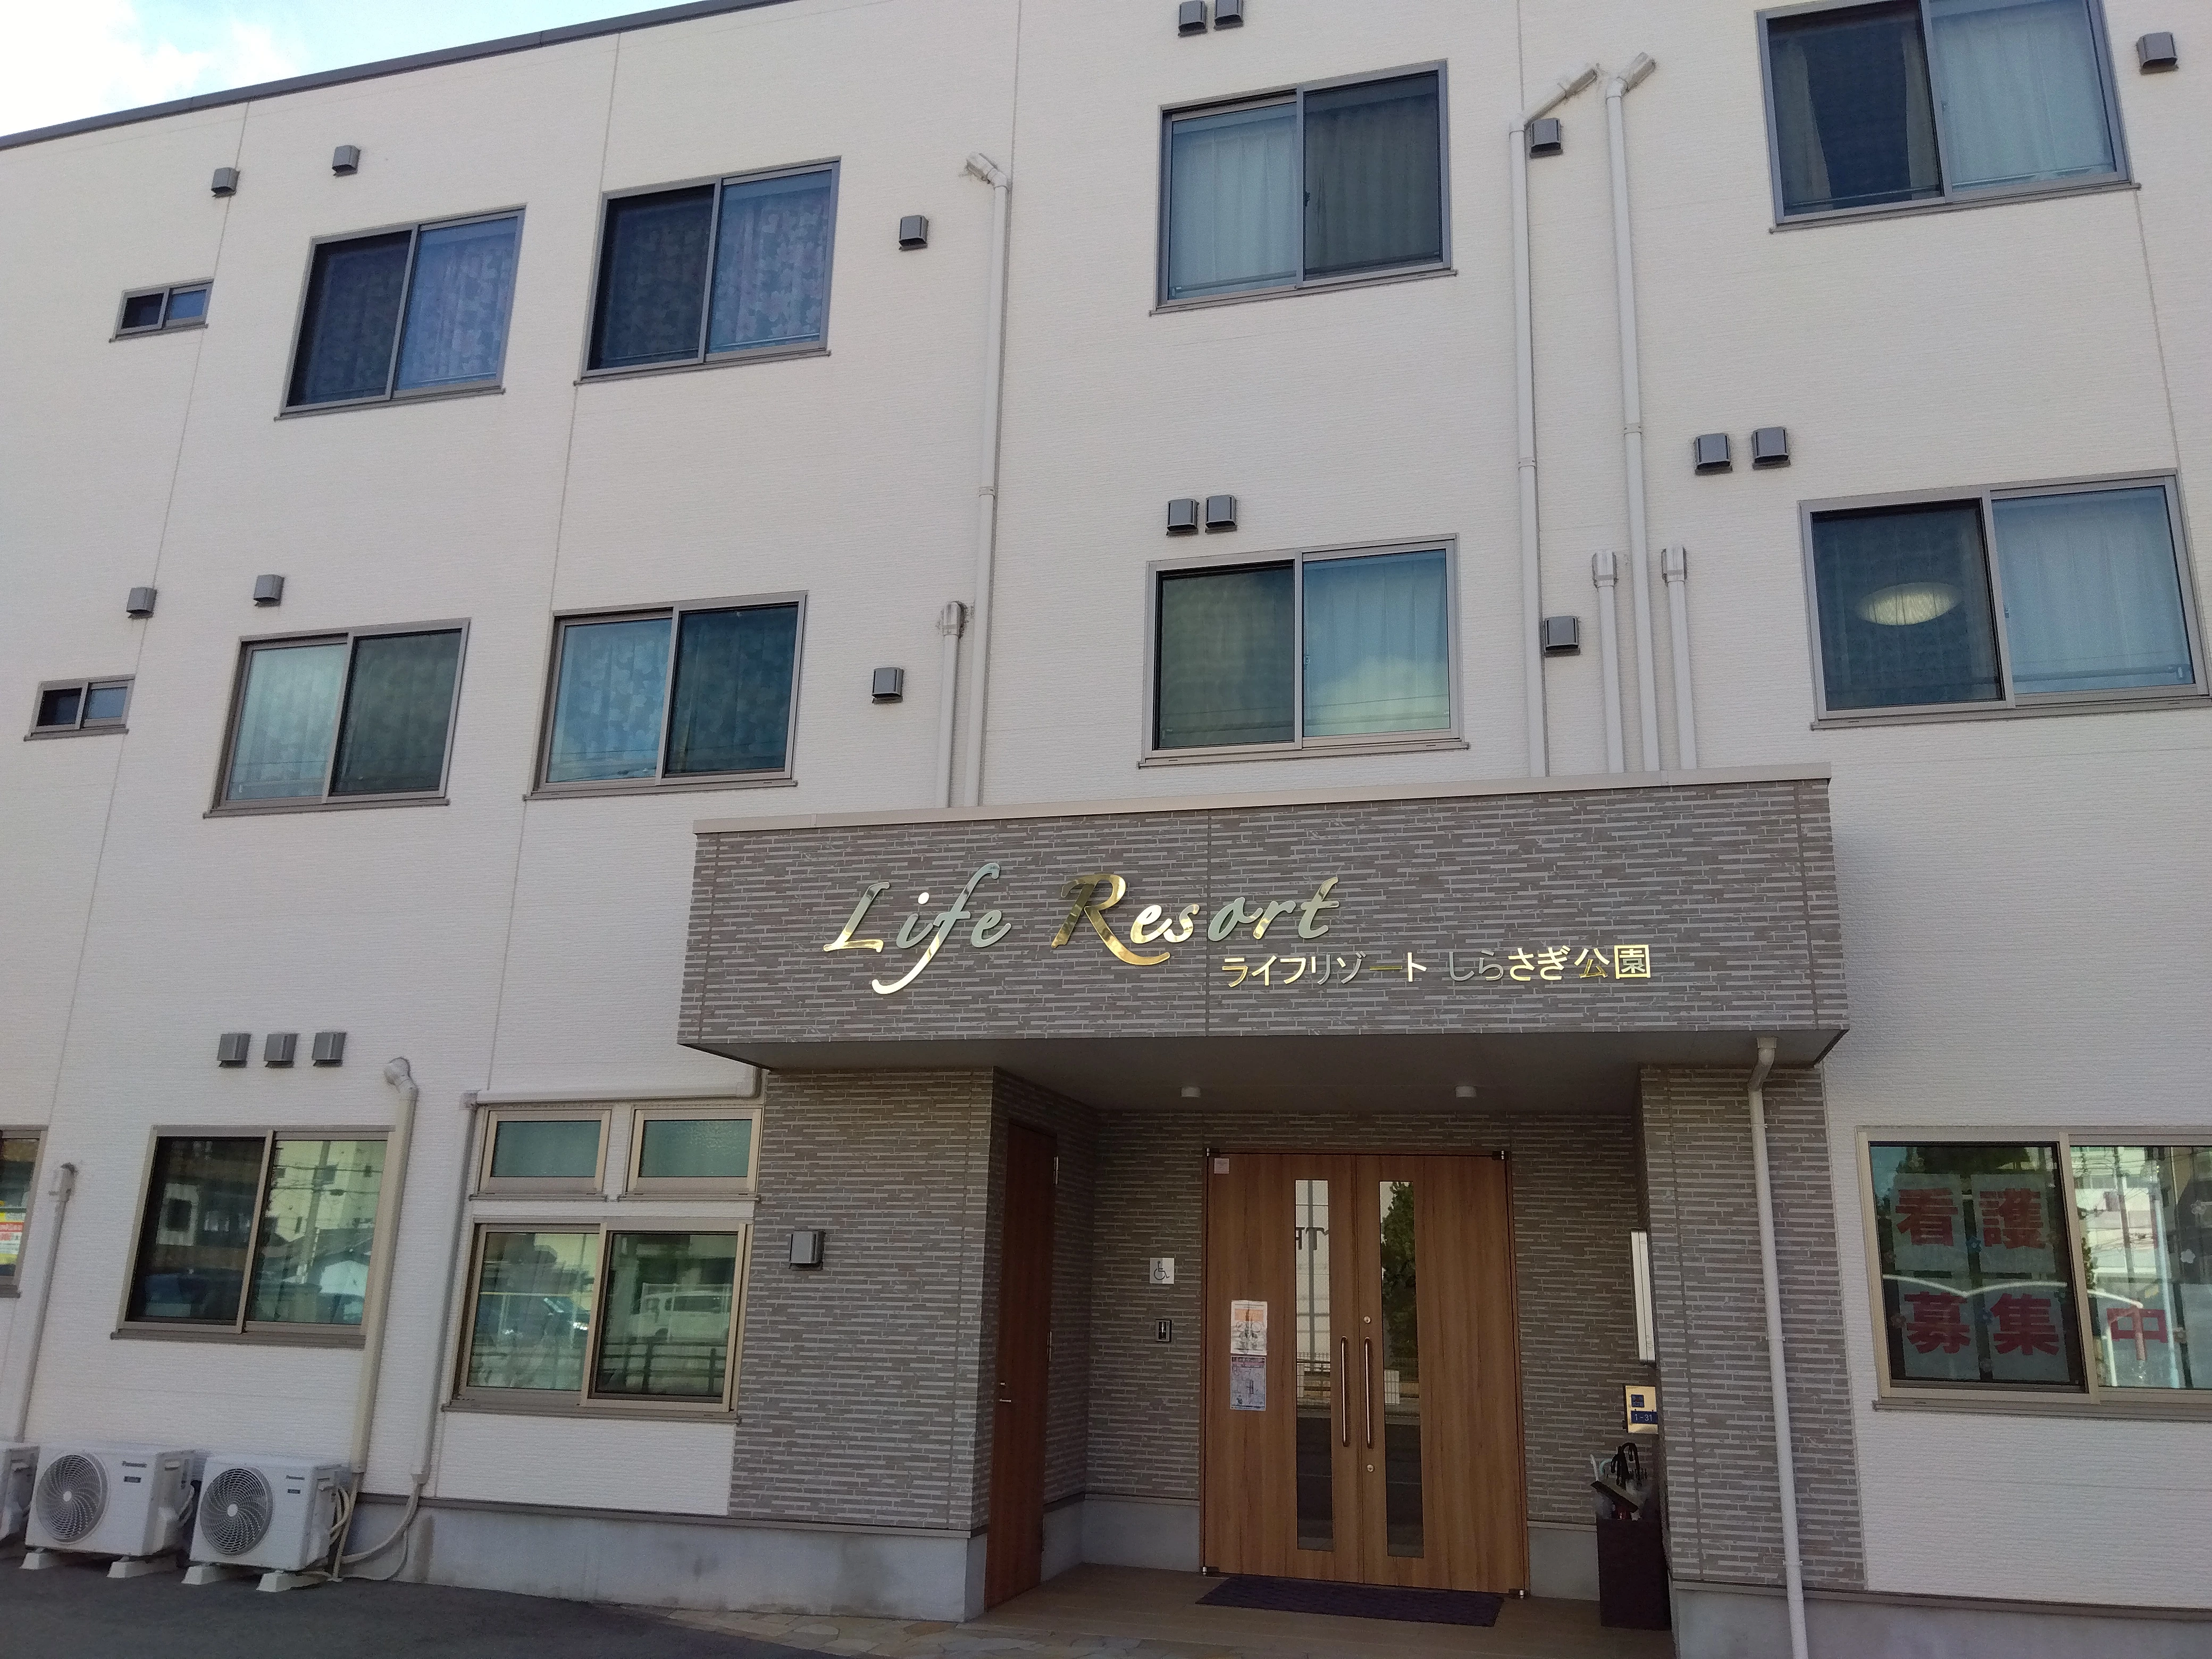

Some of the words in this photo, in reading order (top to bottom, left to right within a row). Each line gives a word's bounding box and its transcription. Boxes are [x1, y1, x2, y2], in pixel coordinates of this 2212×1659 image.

[823, 862, 1011, 994] Life
[1050, 874, 1339, 965] Resort
[1222, 951, 1427, 987] ライフリゾート
[1449, 944, 1651, 981] しらさぎ公園
[1895, 1187, 2046, 1250] 看護
